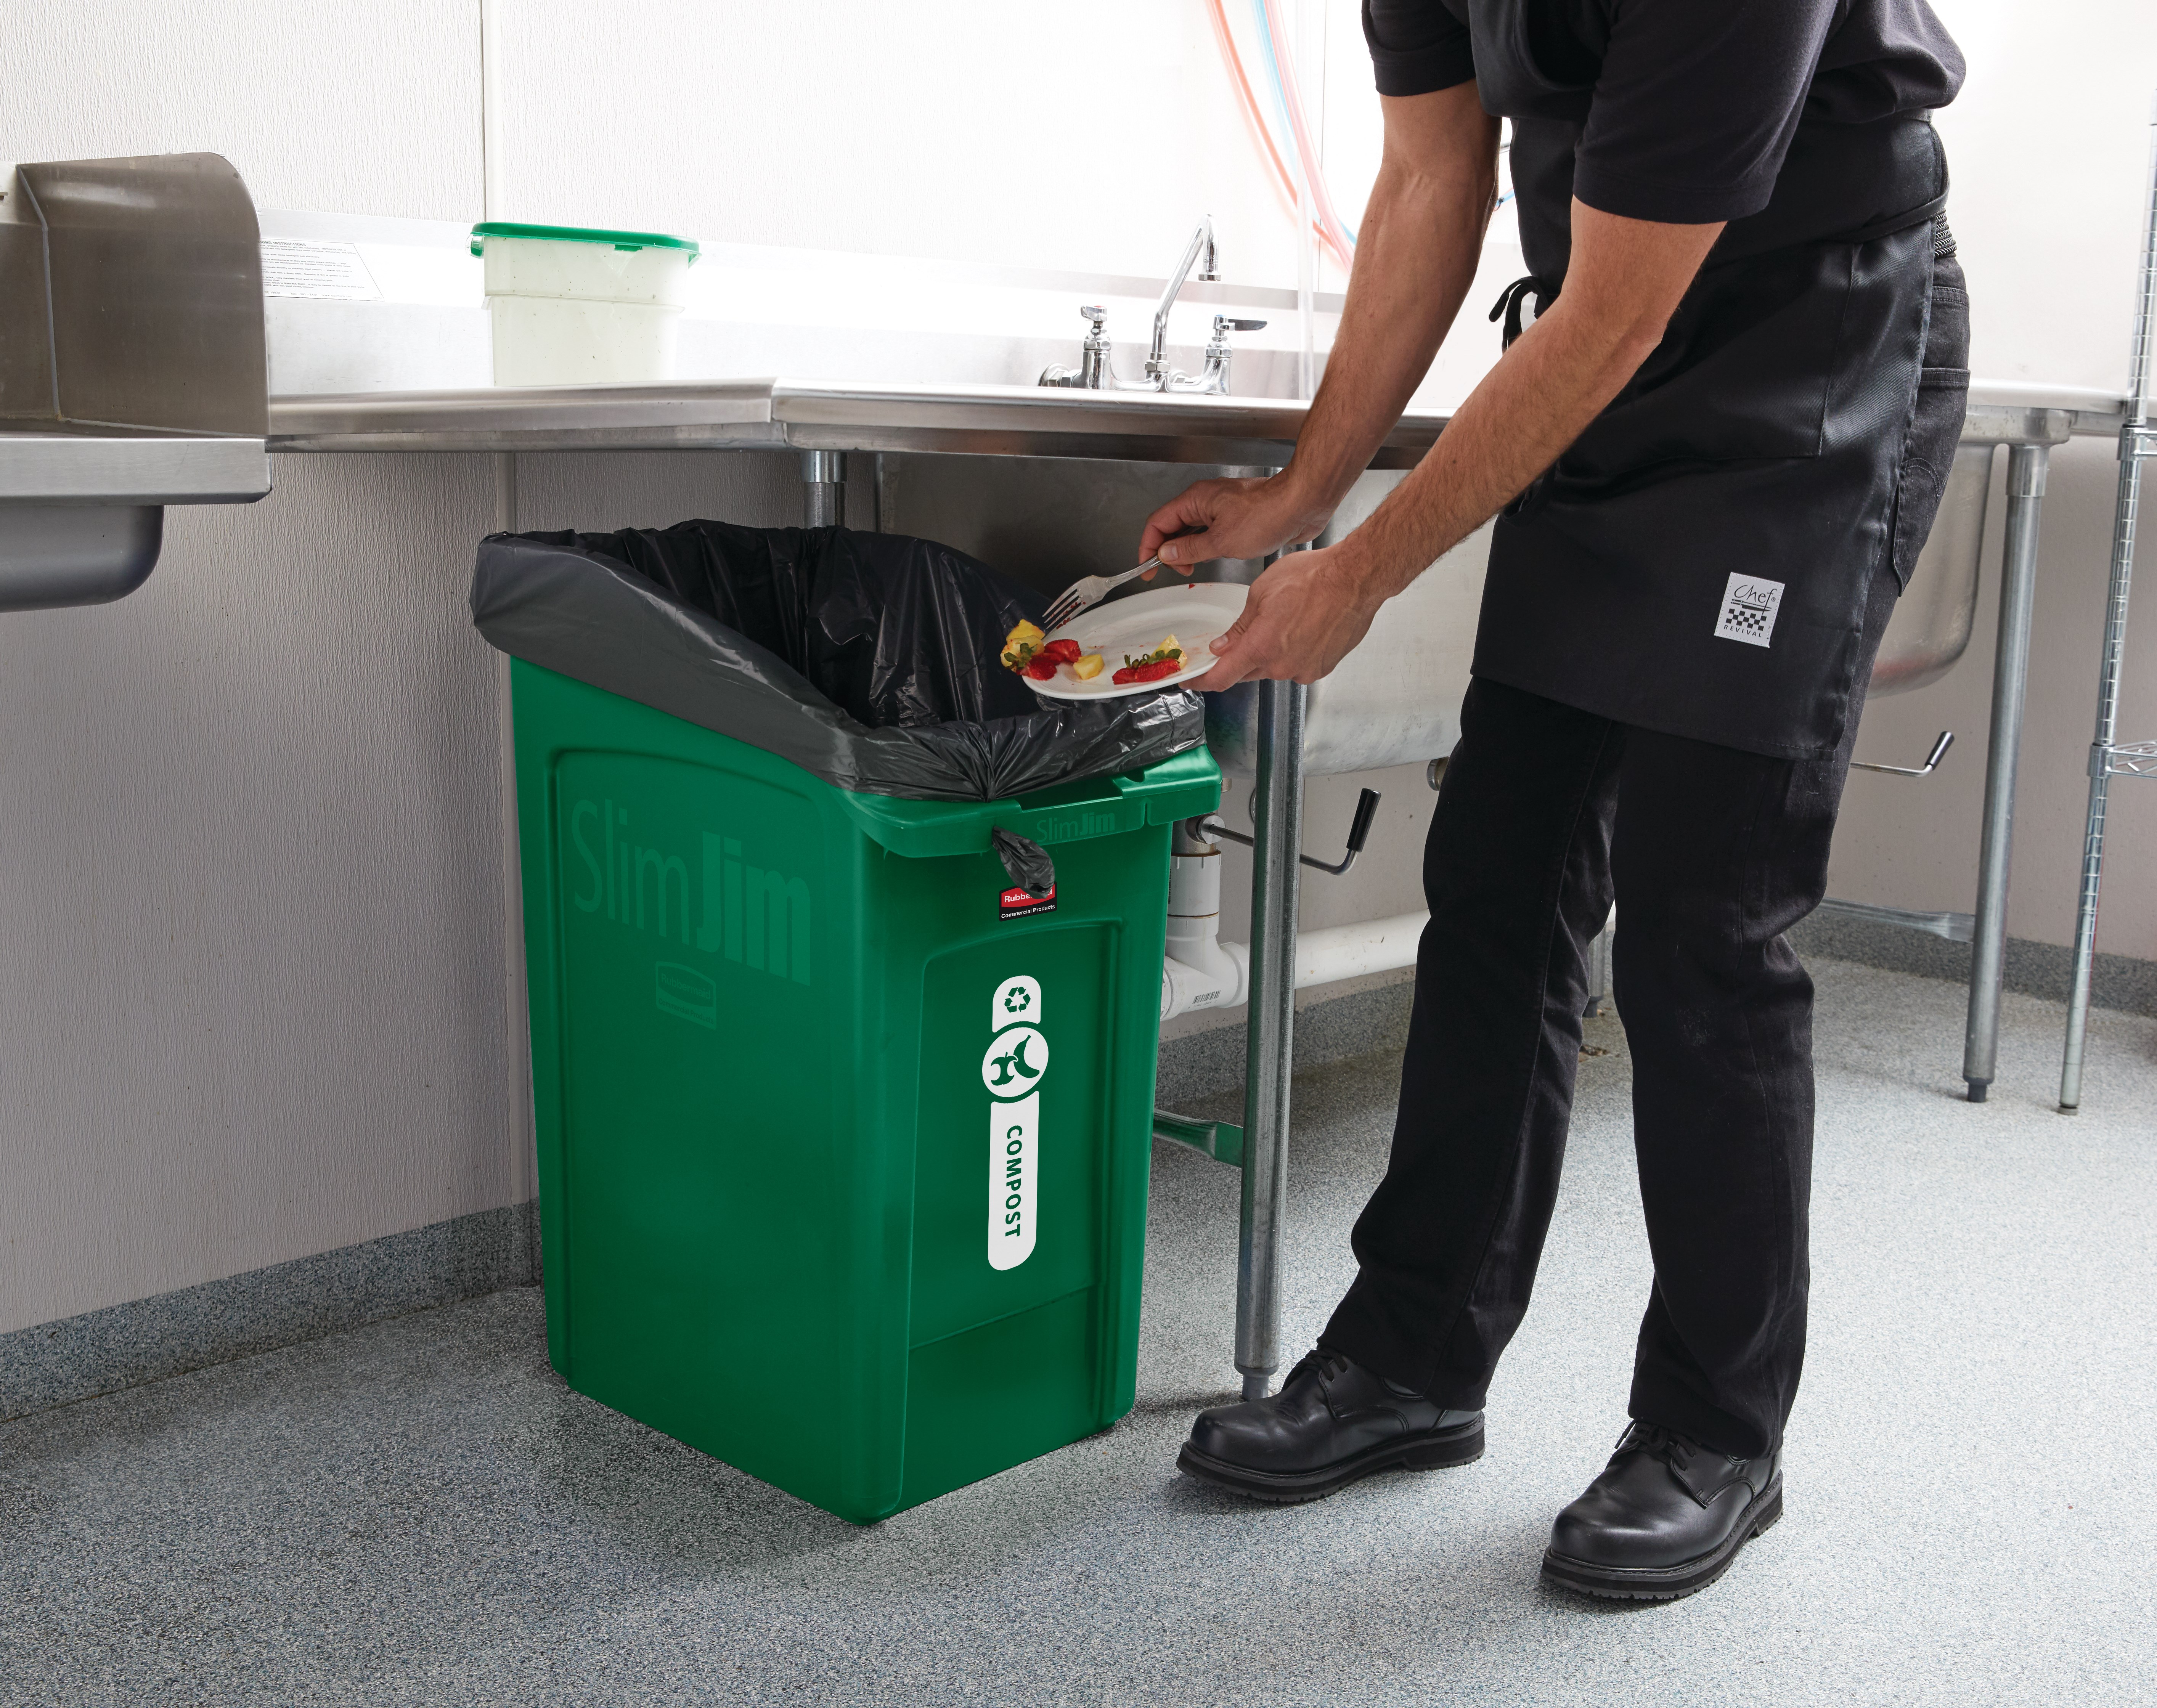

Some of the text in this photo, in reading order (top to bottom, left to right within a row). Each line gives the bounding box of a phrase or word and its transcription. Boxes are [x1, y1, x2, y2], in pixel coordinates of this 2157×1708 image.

[1724, 625, 1762, 637] REVIVAL
[1001, 909, 1032, 918] Commercial
[661, 973, 710, 1000] Rubbermaid
[659, 998, 714, 1024] Commercial Products
[1005, 1125, 1023, 1237] COMPOST
